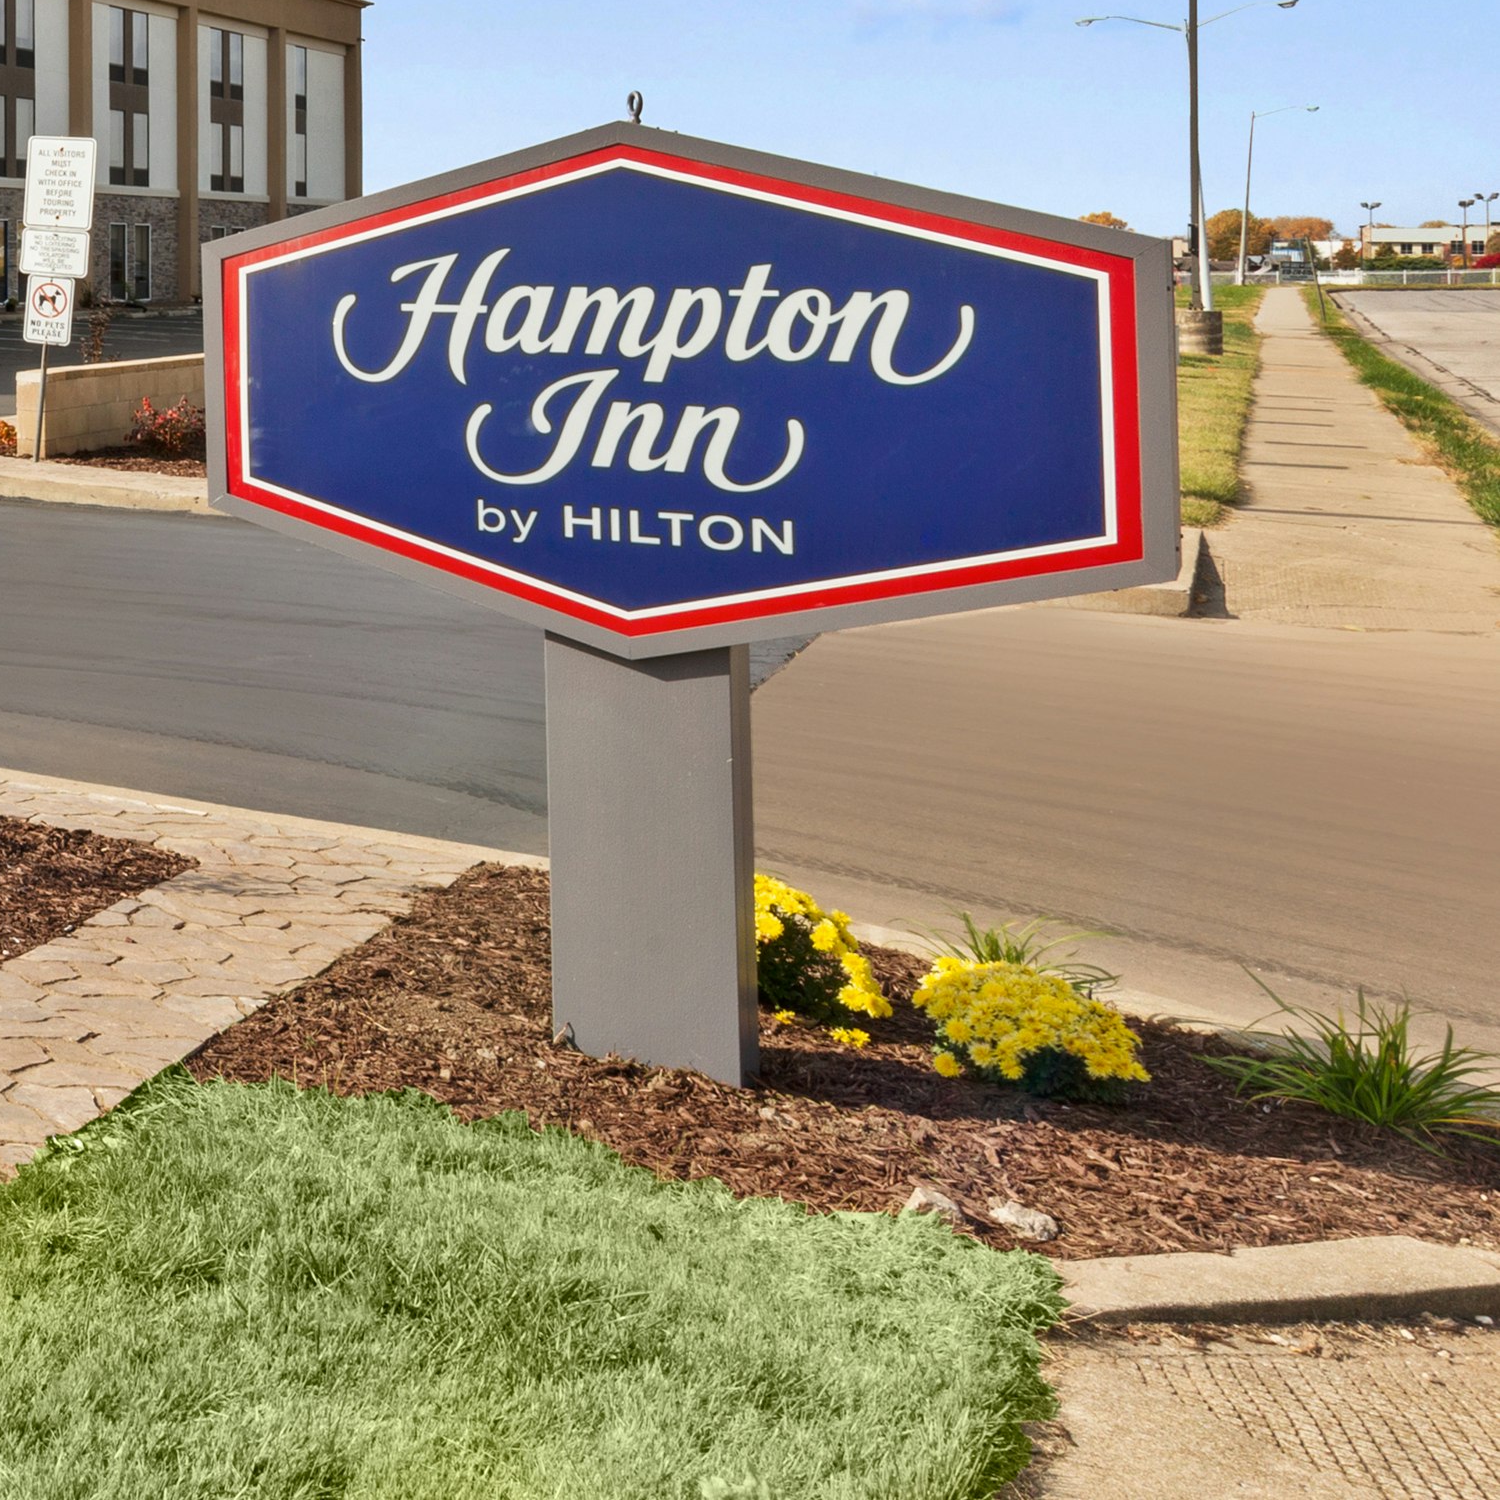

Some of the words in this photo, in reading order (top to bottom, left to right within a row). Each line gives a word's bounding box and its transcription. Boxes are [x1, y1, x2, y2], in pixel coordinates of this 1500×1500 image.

[38, 149, 51, 157] ALL
[53, 150, 86, 158] VISITORS
[51, 160, 71, 168] MUST
[44, 169, 66, 177] CHECK
[57, 180, 83, 188] OFFICE
[45, 189, 72, 197] BEFORE
[43, 198, 75, 207] TOURING
[39, 208, 76, 217] PROPERTY
[40, 246, 80, 254] TRESPASSING
[332, 248, 975, 387] Hampton
[30, 319, 41, 327] NO
[45, 321, 66, 330] PETS
[31, 328, 62, 338] PLEASE
[465, 367, 805, 493] Inn
[476, 498, 538, 543] by
[563, 505, 794, 556] HILTON
